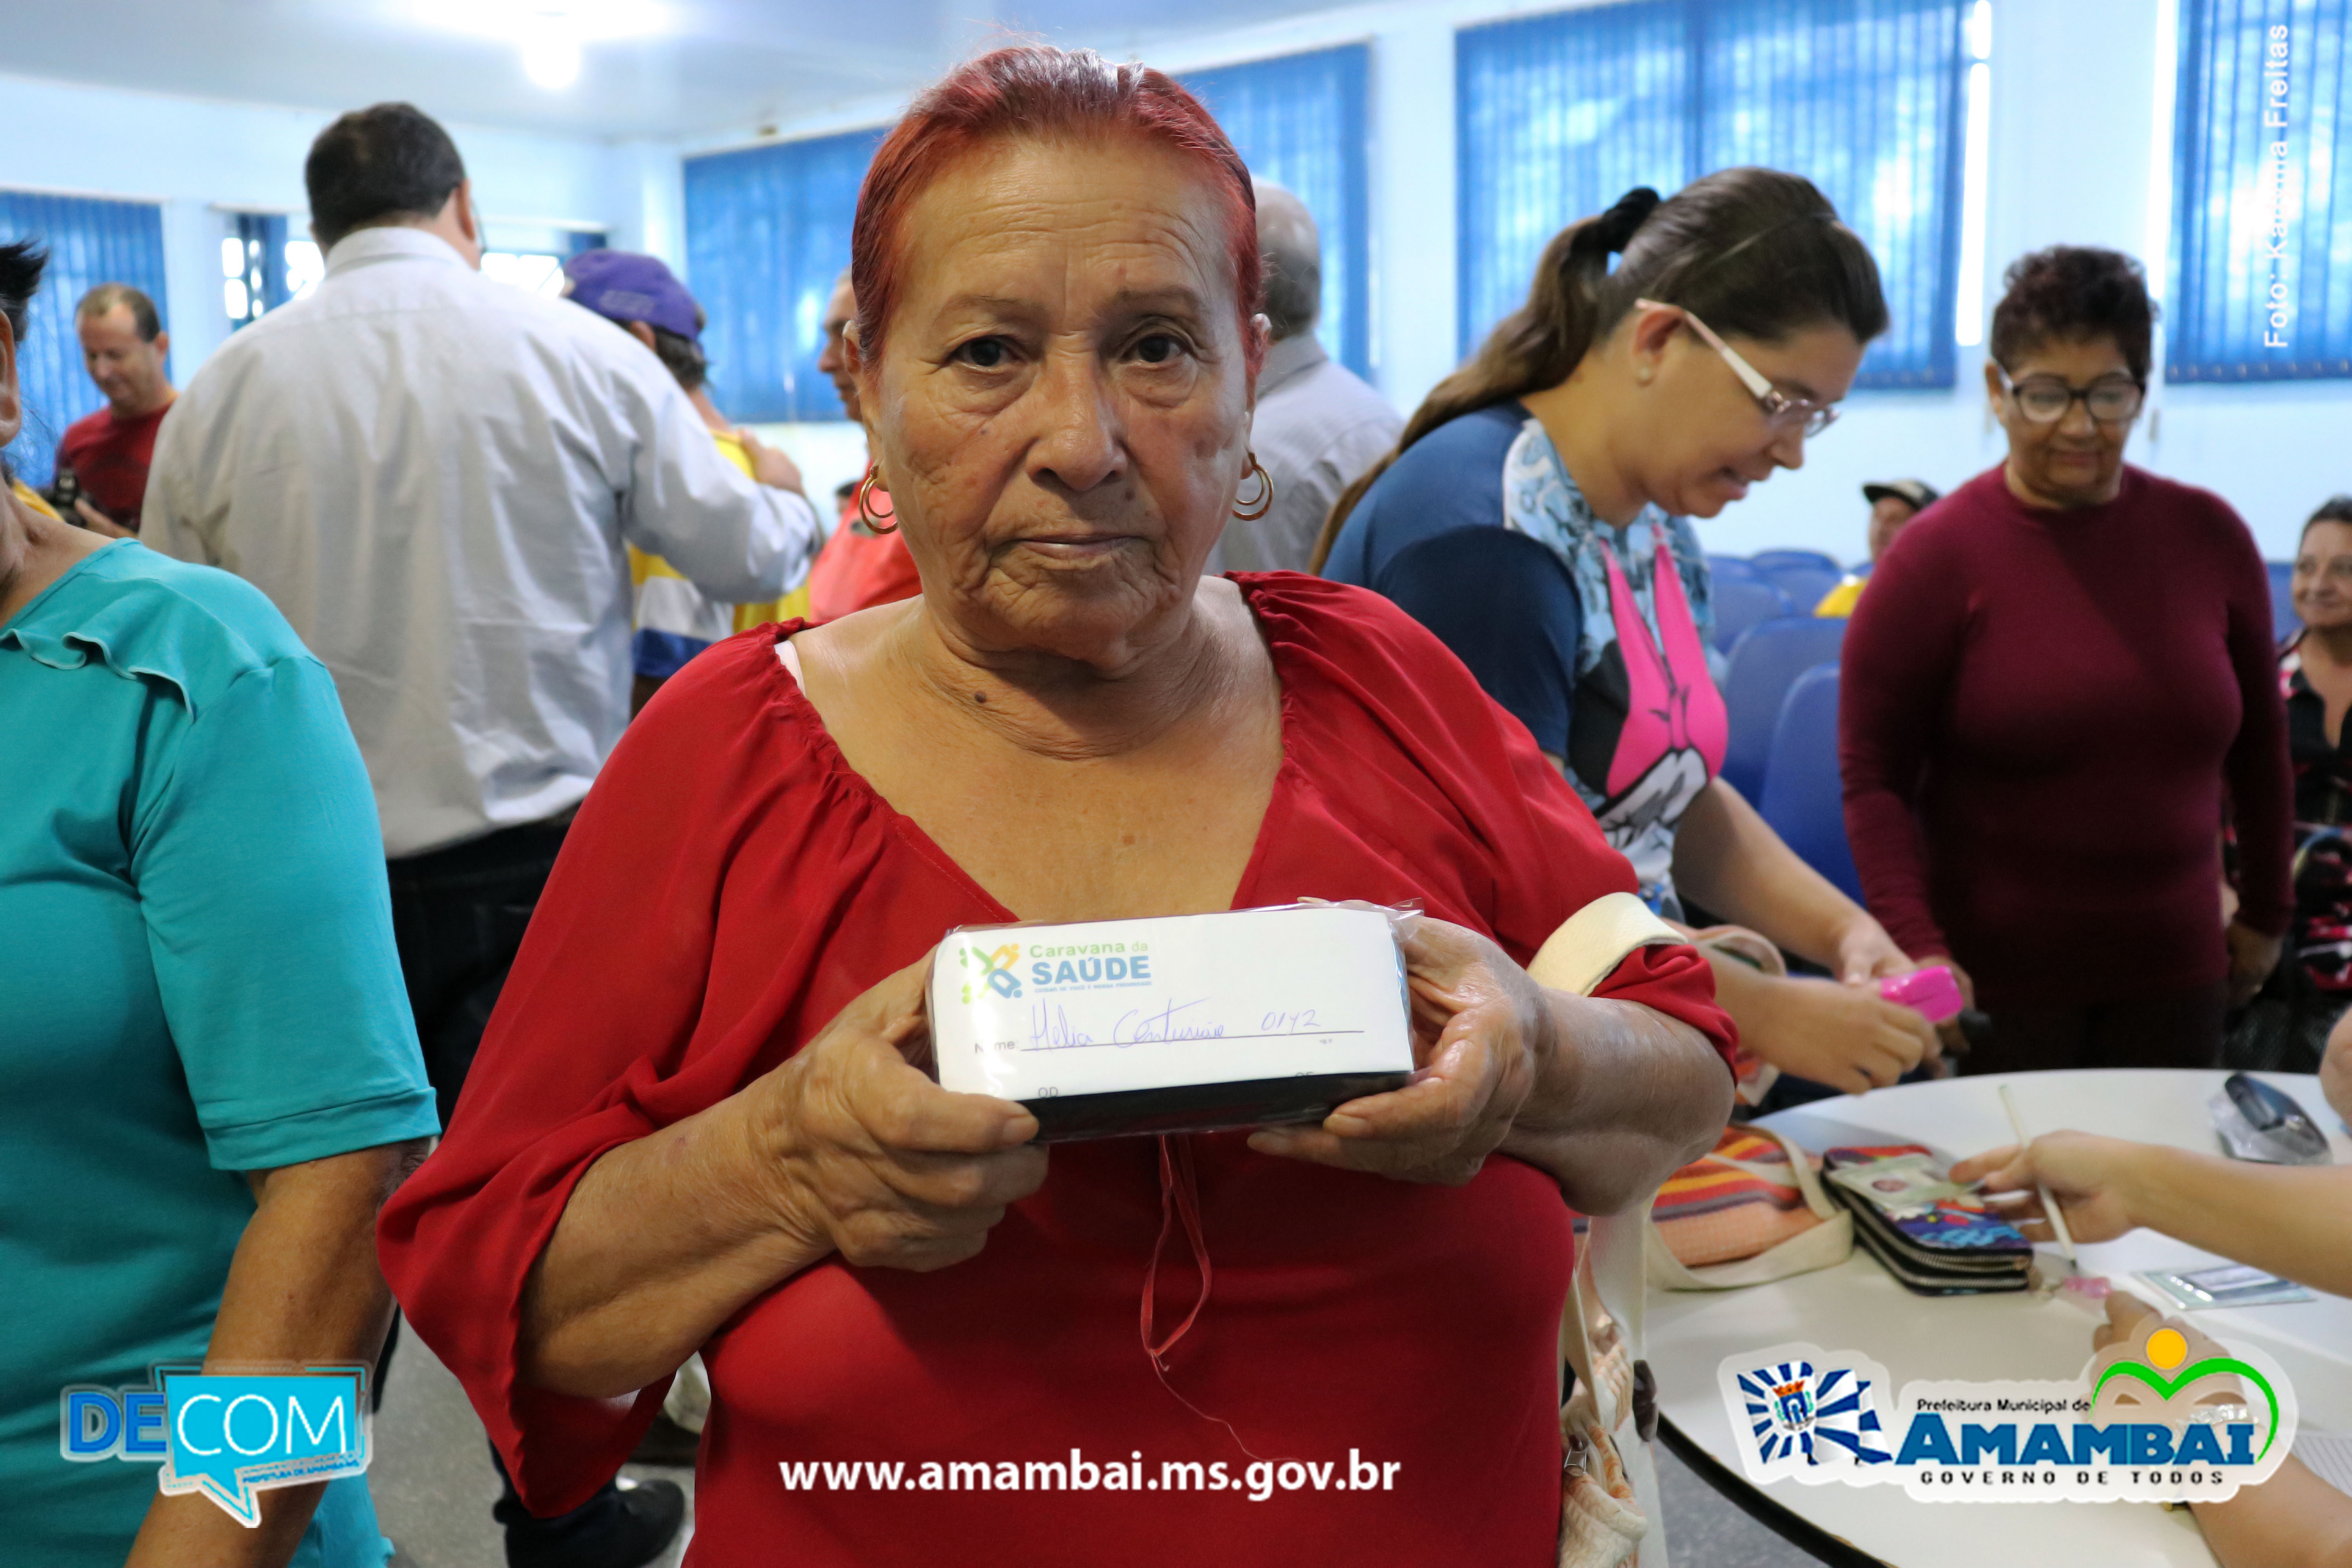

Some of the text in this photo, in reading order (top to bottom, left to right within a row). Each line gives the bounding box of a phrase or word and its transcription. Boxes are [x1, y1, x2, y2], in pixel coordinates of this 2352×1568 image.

[1029, 941, 1148, 958] Caravana da
[1031, 955, 1151, 985] SAÚDE
[975, 1041, 1019, 1054] Nme:
